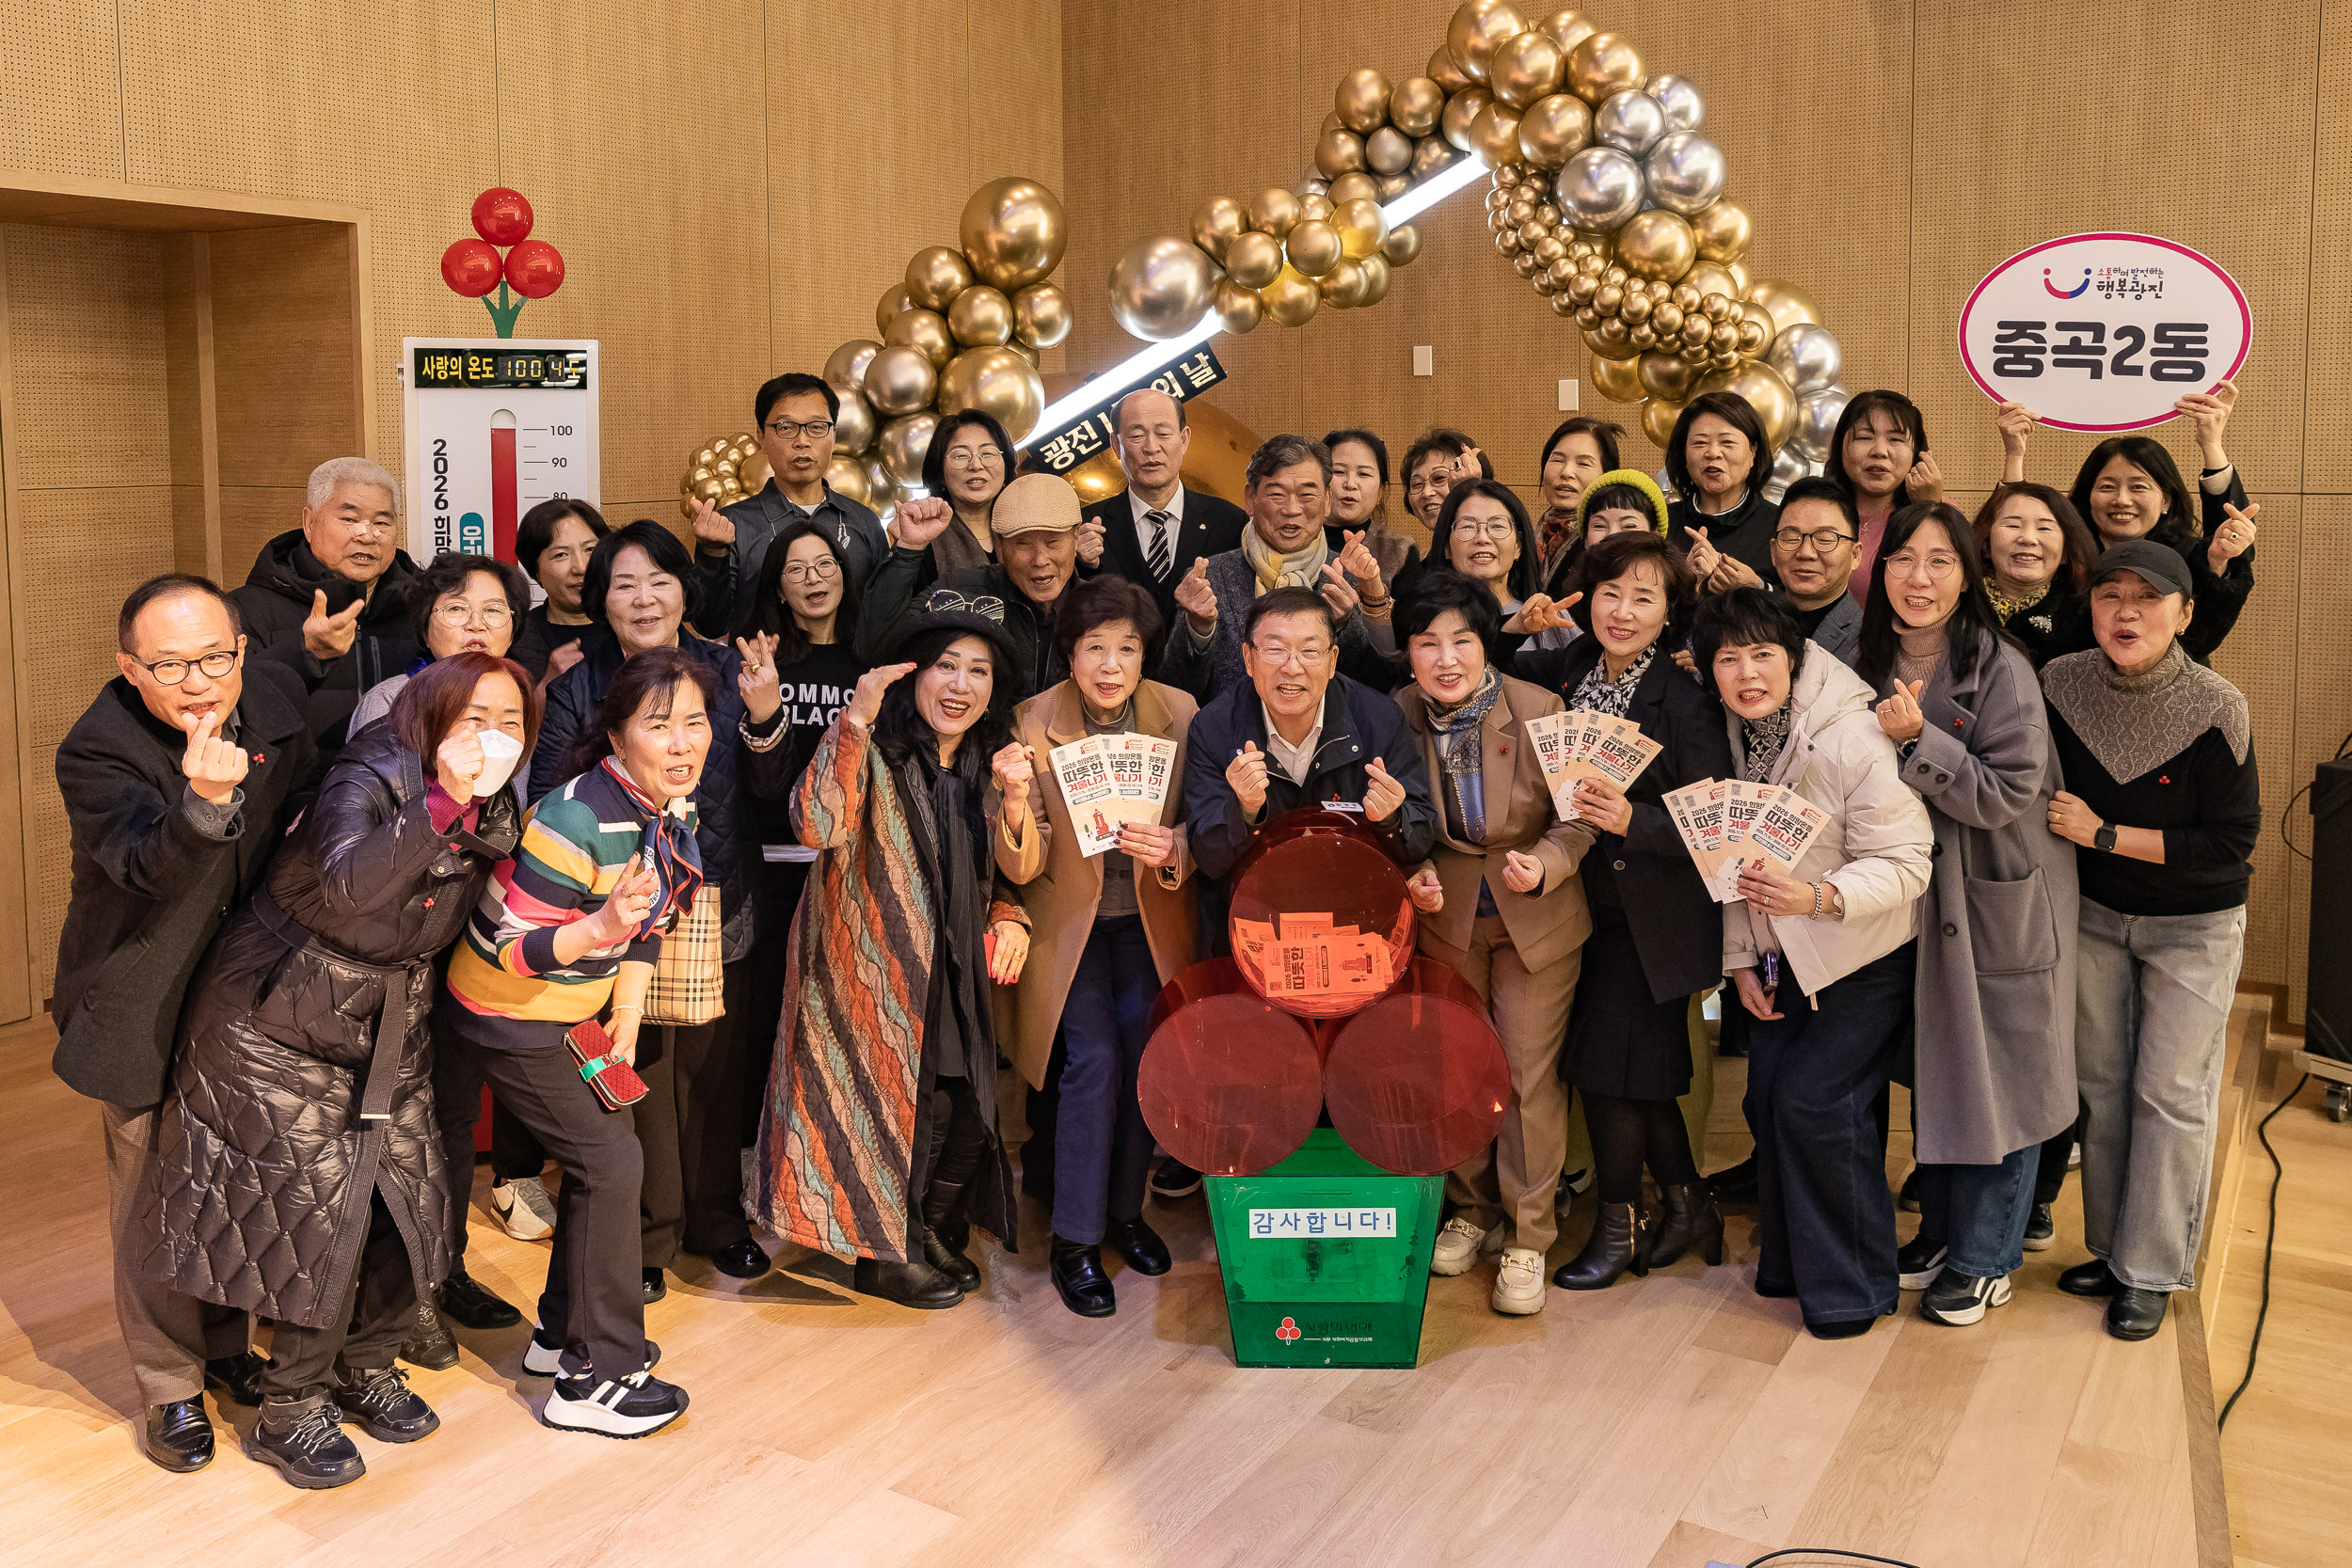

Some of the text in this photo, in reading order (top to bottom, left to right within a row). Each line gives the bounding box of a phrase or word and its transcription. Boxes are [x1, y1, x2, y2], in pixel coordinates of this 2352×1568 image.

[2097, 267, 2164, 280] 소통하며 발전하는
[2096, 279, 2163, 301] 행복광진
[1992, 320, 2209, 382] 중곡2동
[422, 356, 462, 380] 사랑의
[468, 356, 494, 379] 온도
[1040, 352, 1217, 470] 광진 날
[549, 426, 572, 436] 100
[552, 458, 567, 468] 90
[433, 438, 449, 511] 2026
[1609, 735, 1623, 746] 2026
[1596, 748, 1634, 773] 겨울나기
[1601, 740, 1642, 767] 따뜻한
[1061, 762, 1077, 771] 2026
[1063, 760, 1104, 783] 따뜻한
[1067, 773, 1107, 792] 겨울나기
[1113, 774, 1141, 783] 울나기
[1691, 808, 1707, 817] 2026
[1694, 811, 1723, 829] 따뜻
[1773, 804, 1789, 816] 2026
[1758, 820, 1801, 851] 겨울나기
[1765, 809, 1808, 843] 따뜻한
[1291, 947, 1305, 990] 따뜻한
[1253, 1212, 1392, 1234] 감사합니다!
